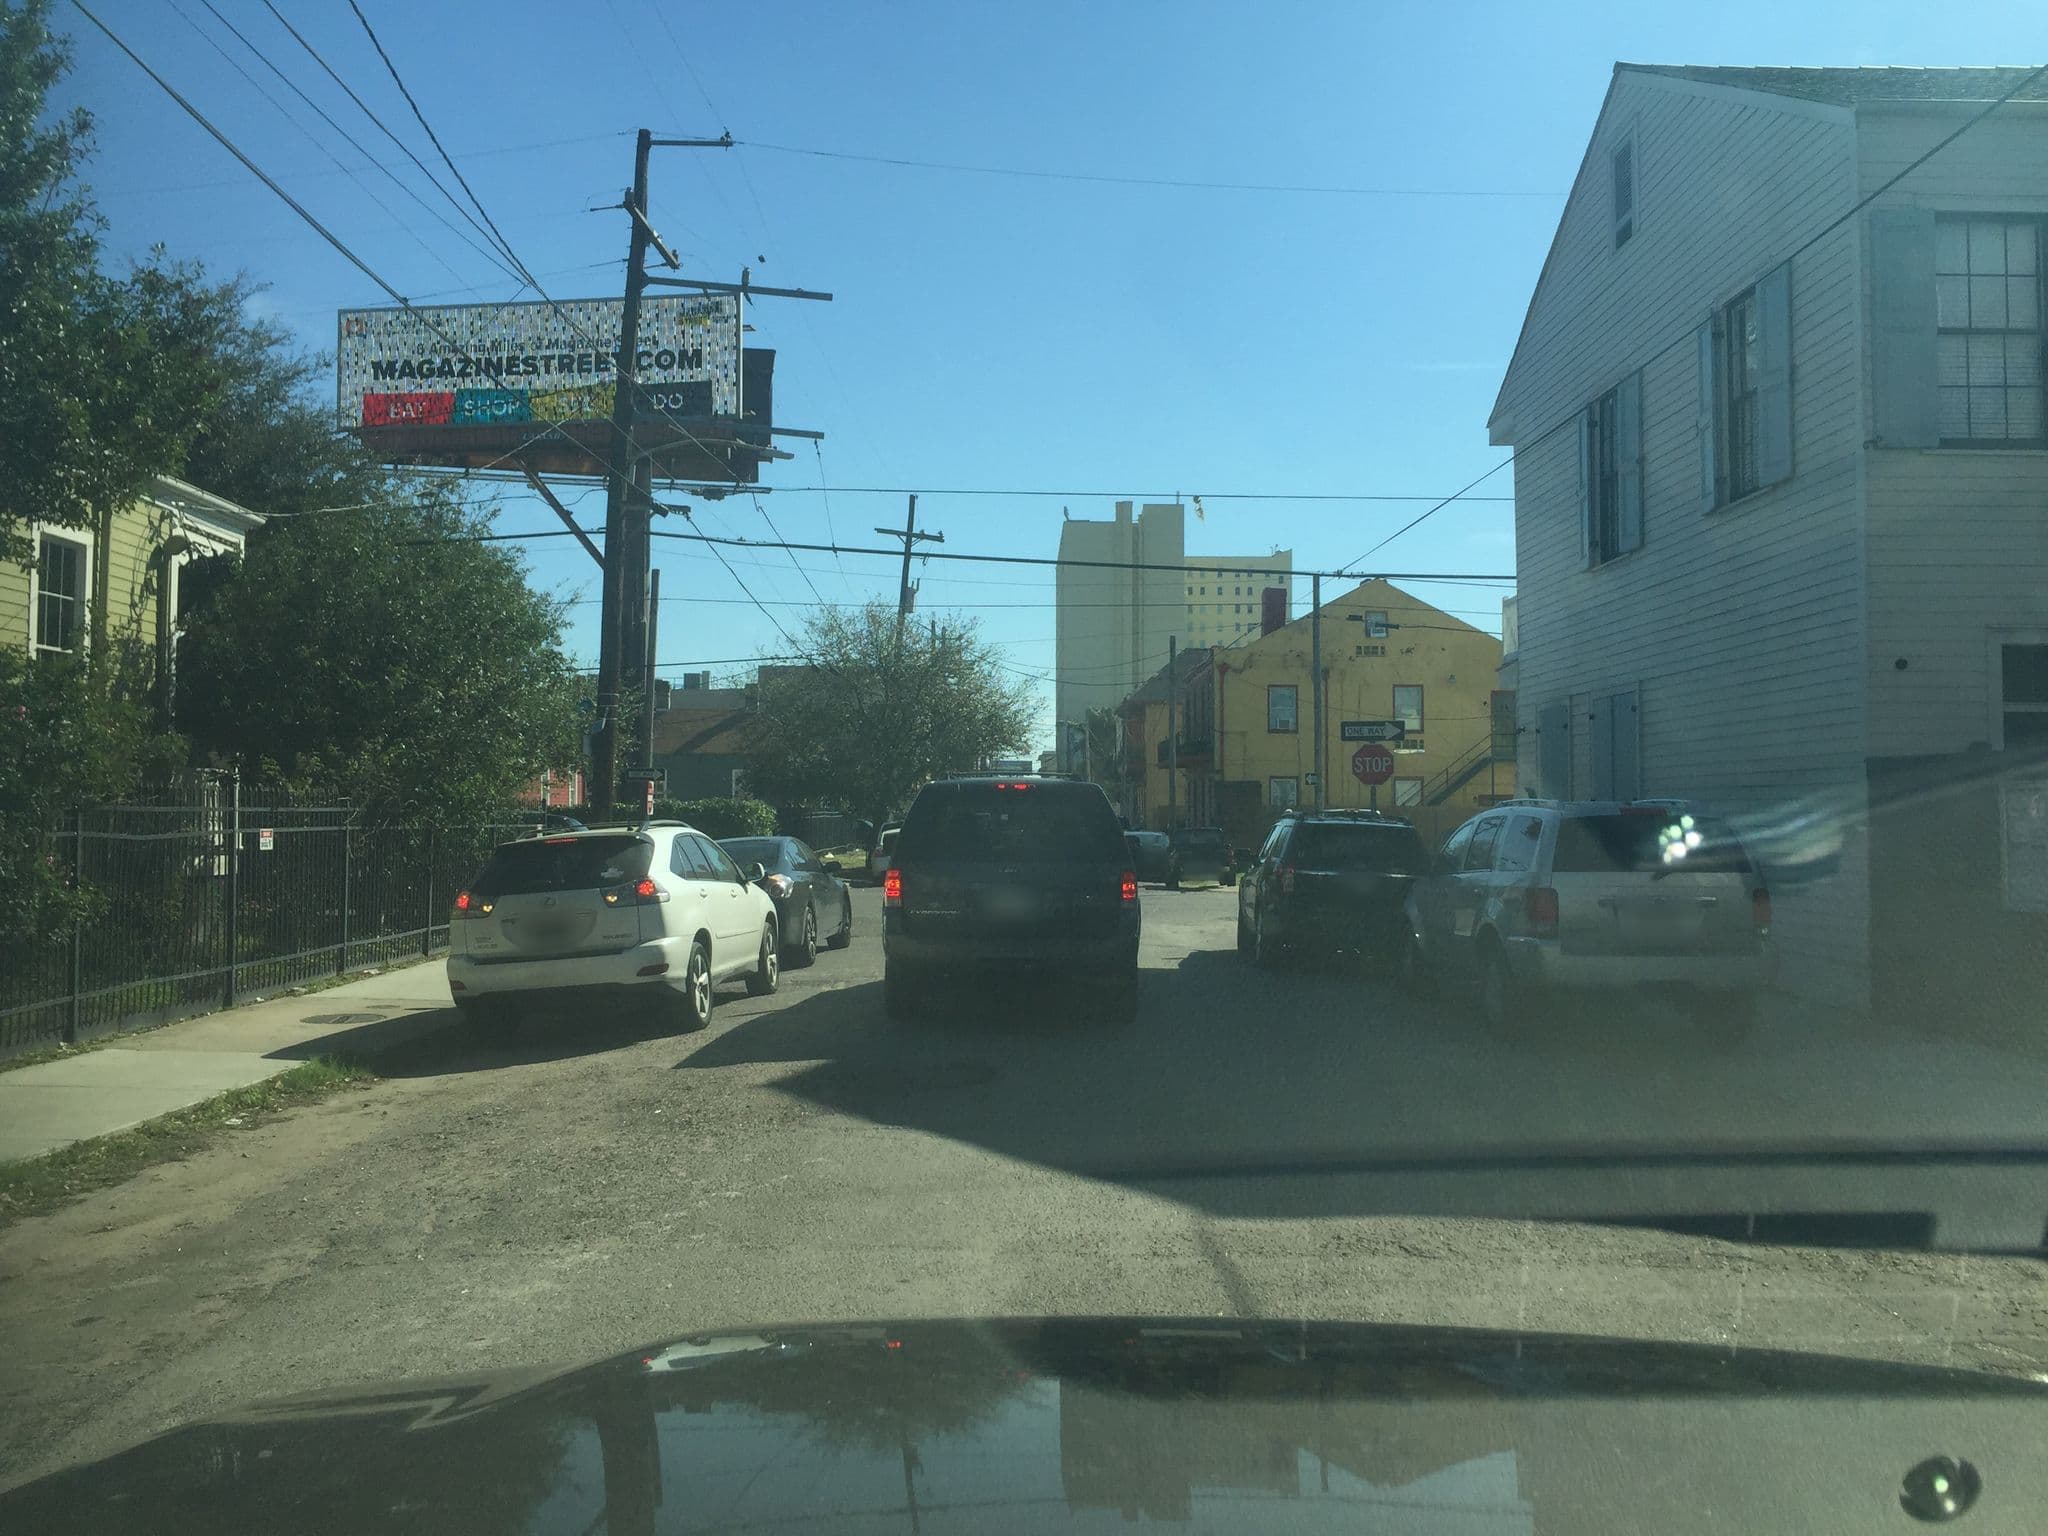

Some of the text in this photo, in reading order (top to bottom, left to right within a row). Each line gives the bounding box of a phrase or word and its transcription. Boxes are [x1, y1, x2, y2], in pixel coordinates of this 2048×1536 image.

[491, 338, 524, 353] Miles
[547, 336, 612, 352] Magazine
[389, 401, 427, 419] EAT
[464, 398, 519, 416] SHOP
[653, 393, 684, 410] DO
[1346, 727, 1385, 736] ONE WAY
[1354, 757, 1392, 773] STOP
